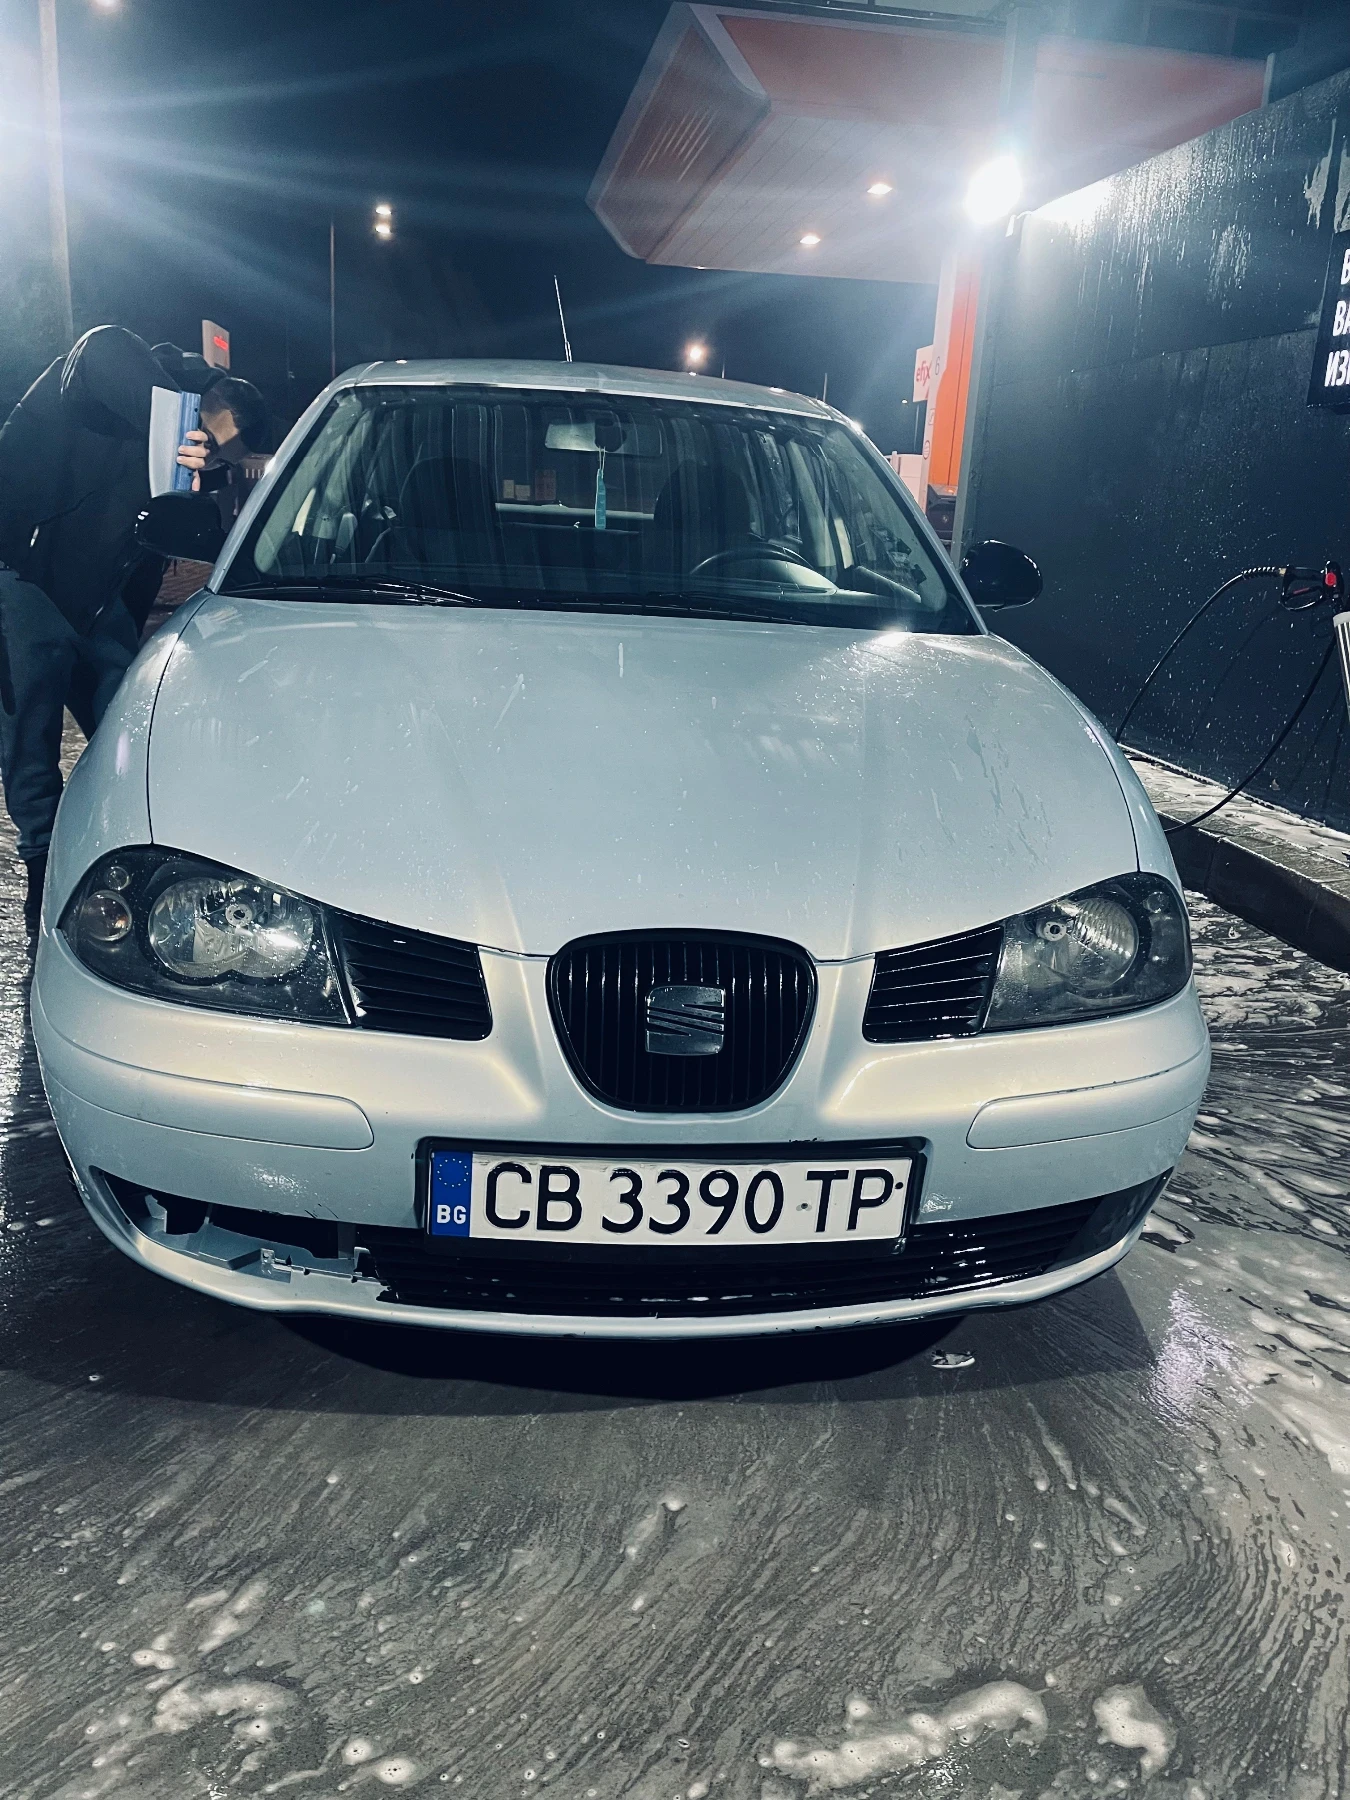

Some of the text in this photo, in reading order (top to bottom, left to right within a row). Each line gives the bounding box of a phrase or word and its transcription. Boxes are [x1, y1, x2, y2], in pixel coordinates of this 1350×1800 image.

[436, 1204, 467, 1225] BG
[485, 1162, 894, 1235] CB 3390 TP
